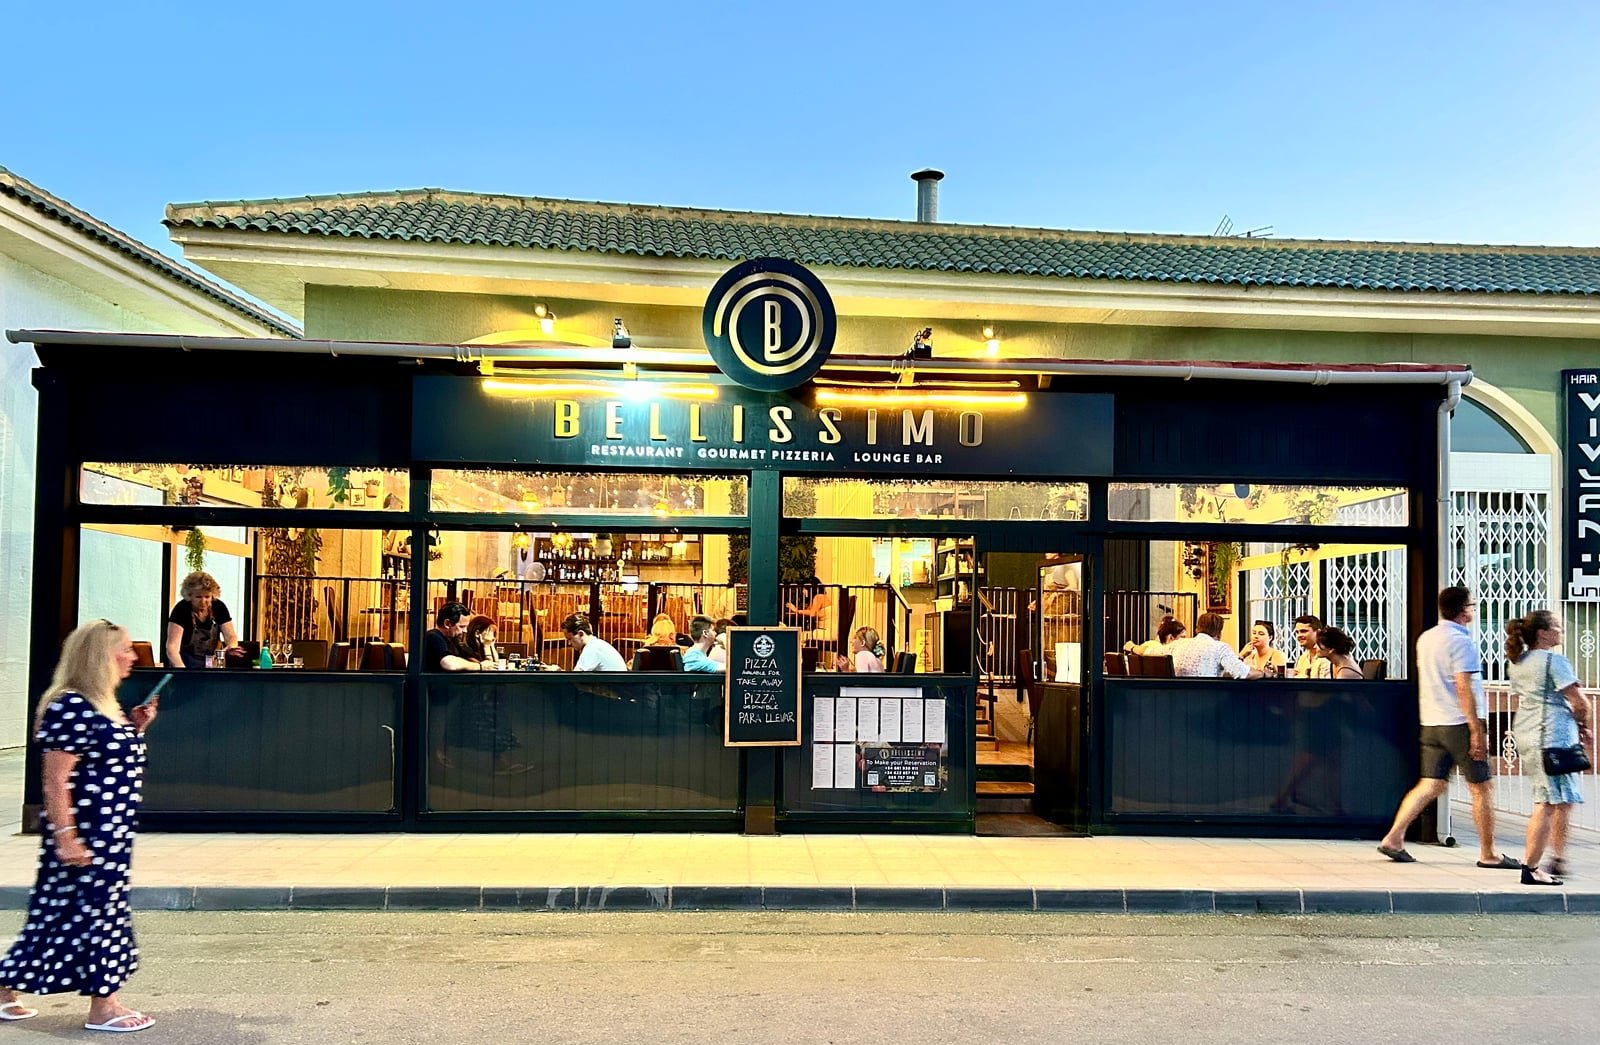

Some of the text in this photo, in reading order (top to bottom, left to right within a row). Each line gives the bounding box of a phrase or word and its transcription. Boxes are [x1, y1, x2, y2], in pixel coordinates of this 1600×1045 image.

[1570, 374, 1598, 384] HAIR
[553, 400, 983, 447] BELLISSIMO
[591, 445, 835, 462] RESTAURANT GOURMET PIZZERIA
[854, 452, 943, 464] LOUNGE BAR
[745, 657, 777, 669] PIZZA
[736, 678, 783, 687] TAKE AWAY
[744, 693, 777, 704] PIZZA
[738, 712, 762, 724] PARA
